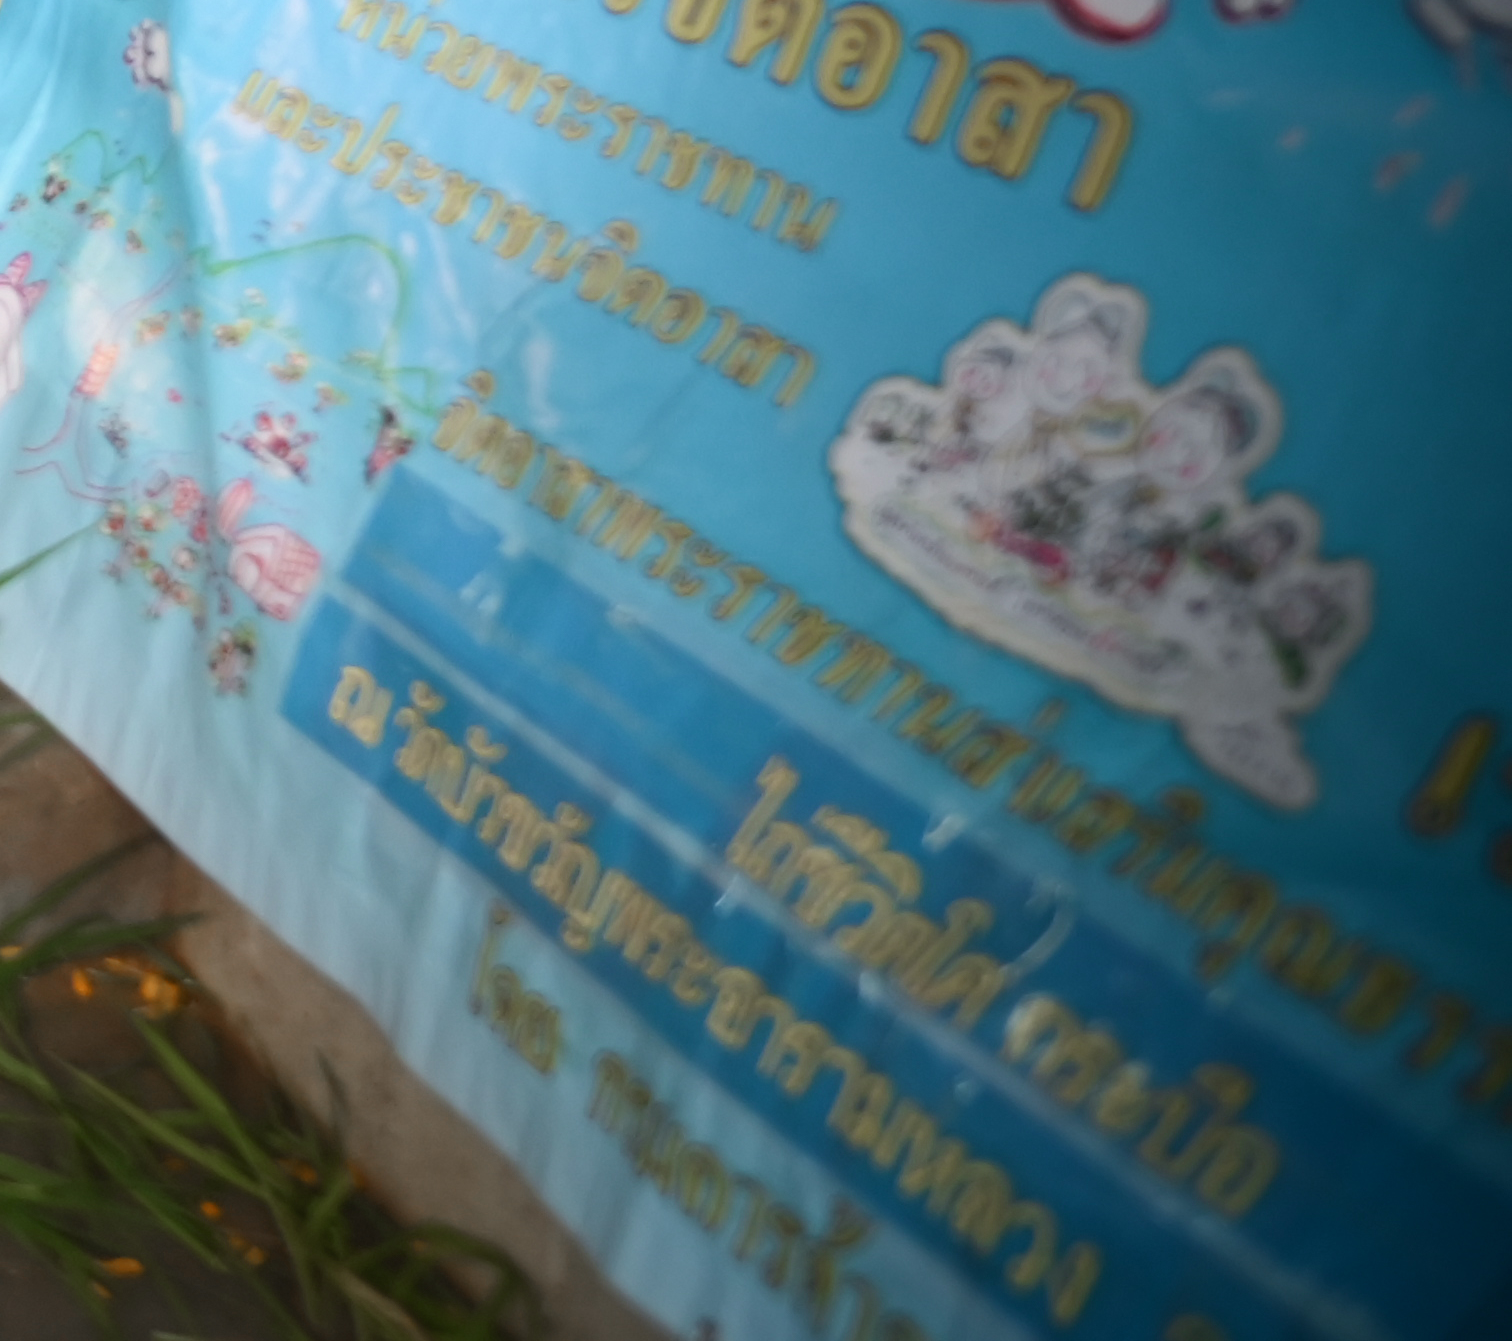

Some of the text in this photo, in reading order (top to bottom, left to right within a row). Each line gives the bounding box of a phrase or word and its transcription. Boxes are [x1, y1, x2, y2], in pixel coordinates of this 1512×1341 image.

[230, 69, 815, 408] และประชาชนจิตอาสา
[470, 899, 563, 1079] โดย
